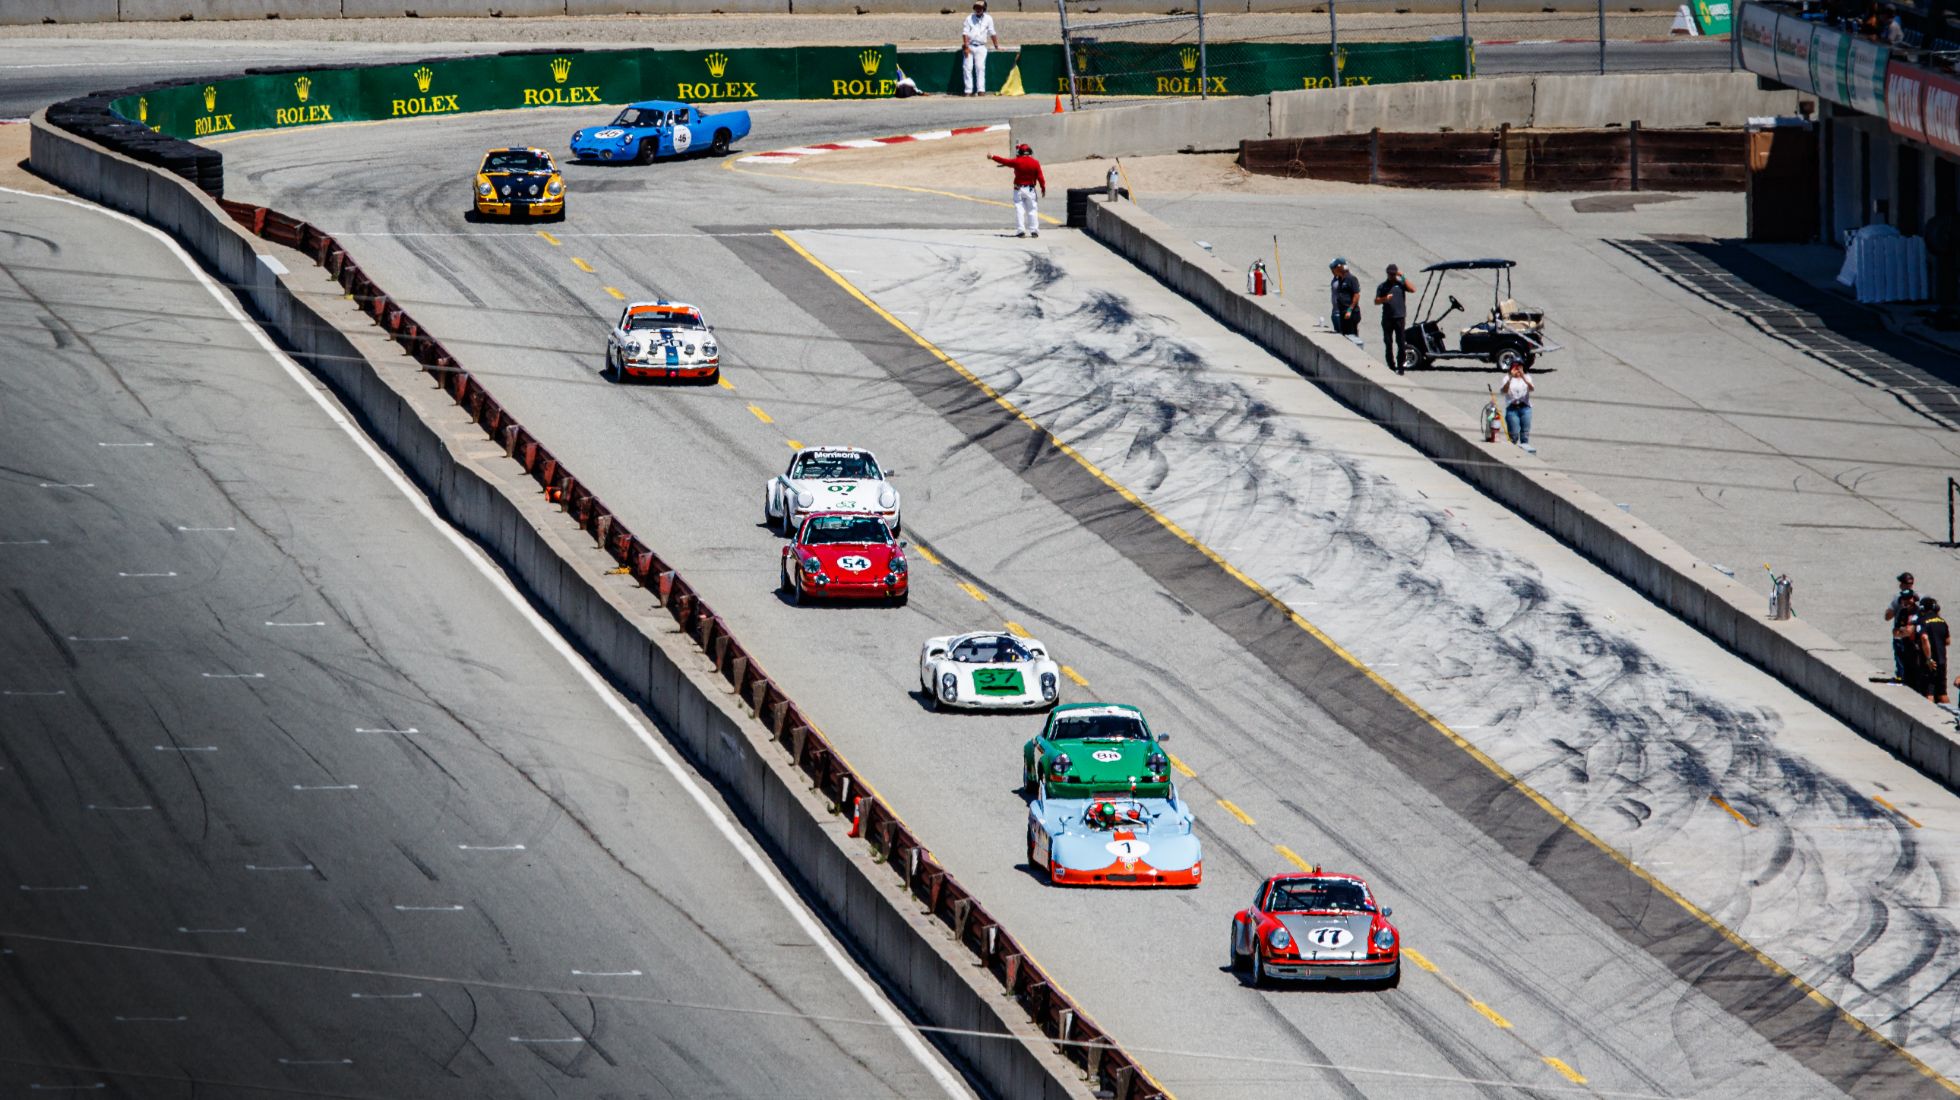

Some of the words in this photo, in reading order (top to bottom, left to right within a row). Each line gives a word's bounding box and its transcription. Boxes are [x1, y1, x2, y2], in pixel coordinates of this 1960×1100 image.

[677, 82, 758, 100] ROLEX
[1156, 76, 1228, 94] ROLEX
[1303, 76, 1373, 90] ROEX
[523, 86, 602, 105] ROLEX
[276, 104, 333, 125] ROLEX
[391, 94, 460, 117] ROLEX
[194, 113, 236, 136] ROLEX
[678, 134, 687, 143] 46
[827, 485, 857, 493] 07
[842, 557, 868, 569] 54
[978, 671, 1016, 685] 37
[1314, 927, 1343, 945] 77
